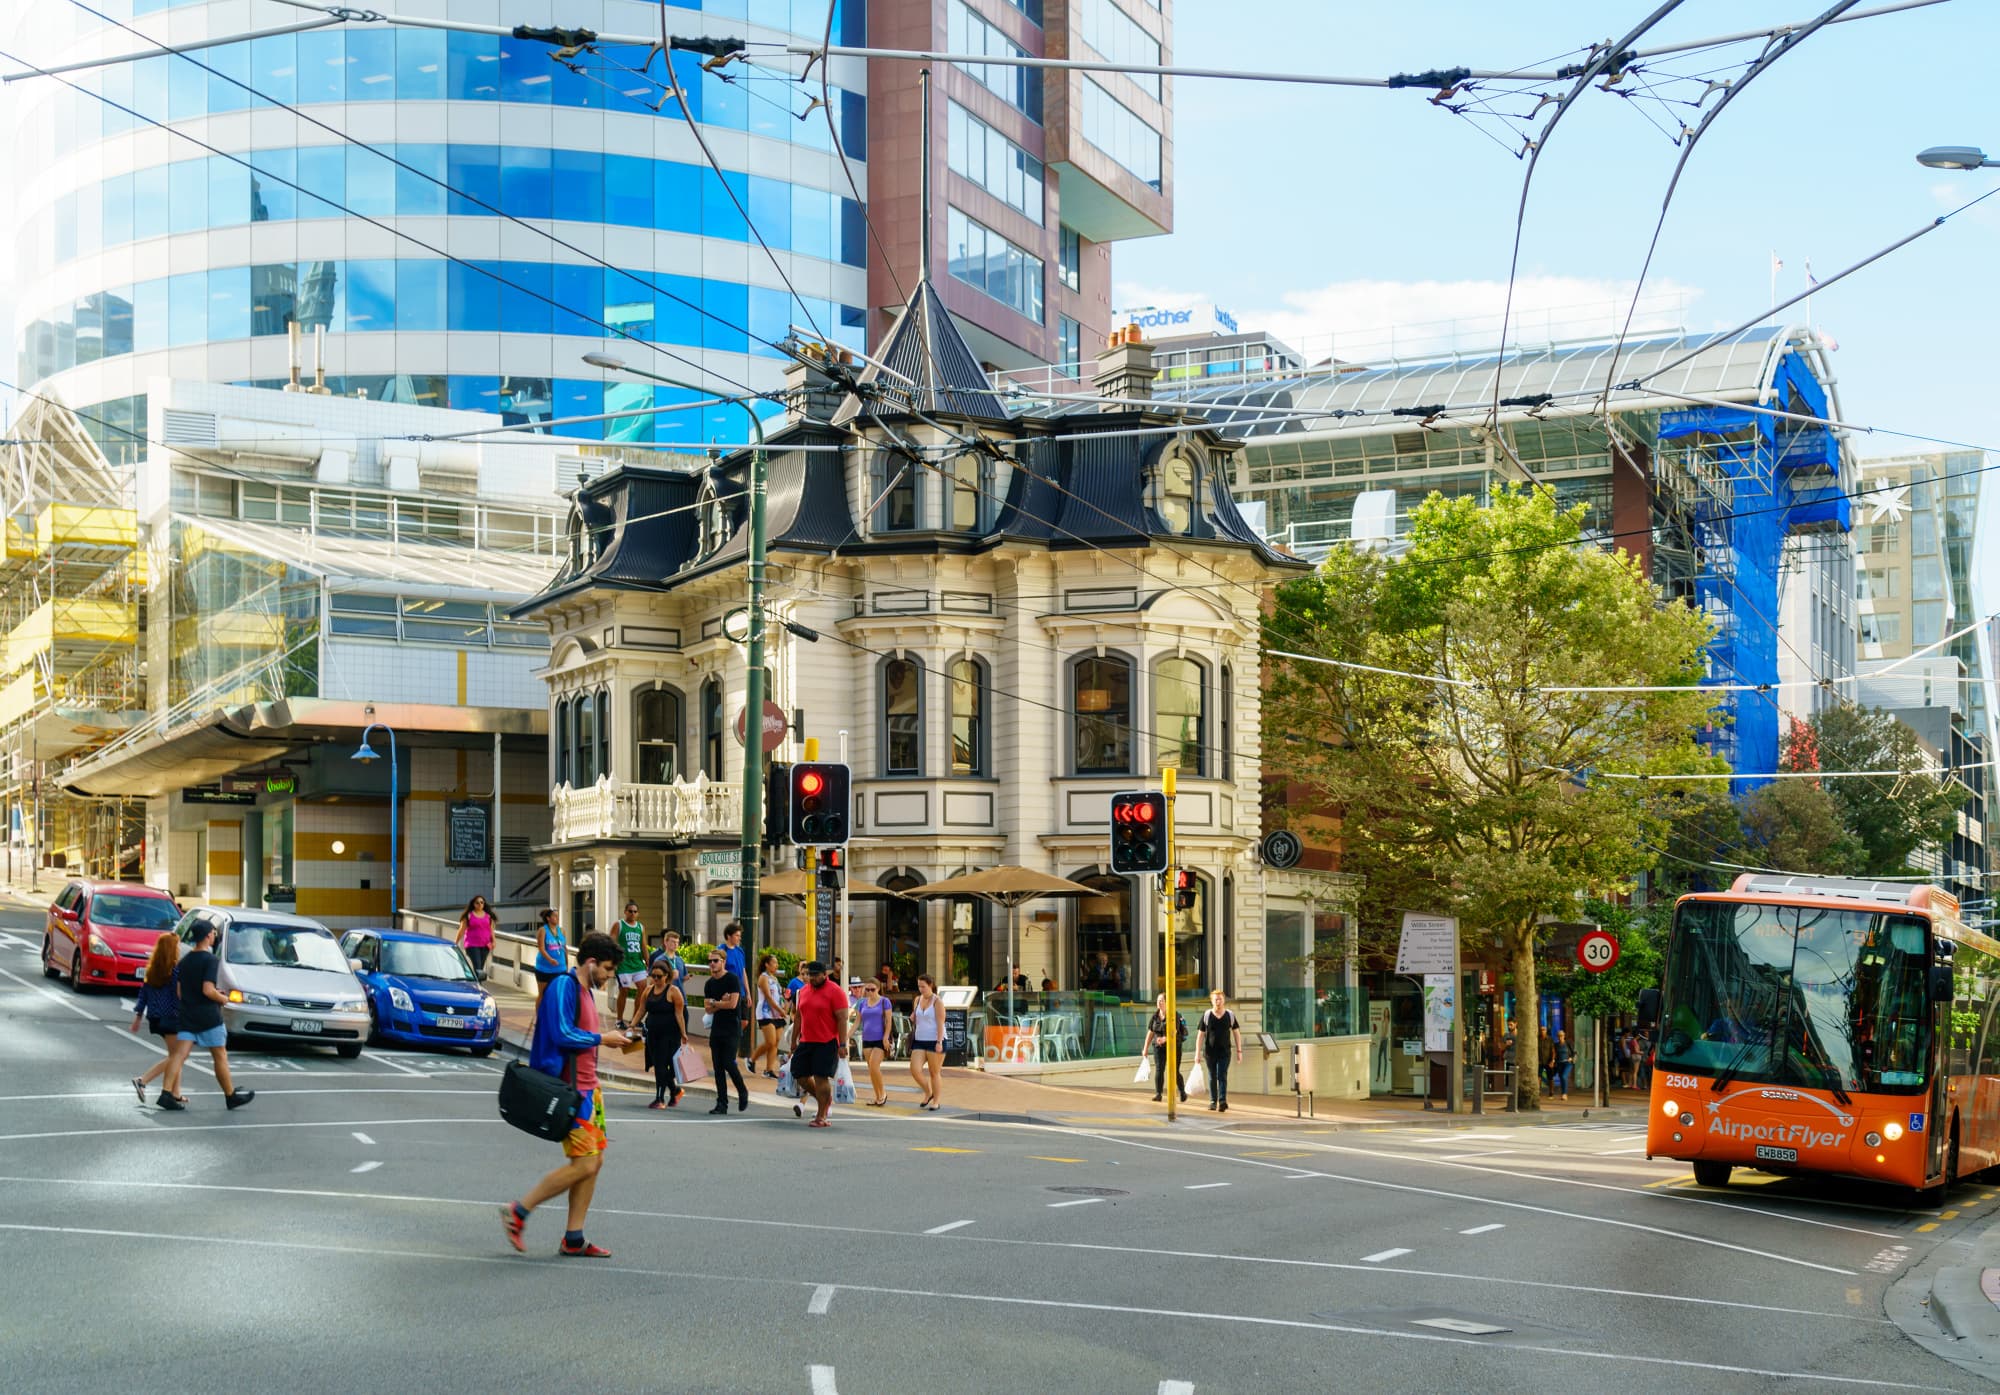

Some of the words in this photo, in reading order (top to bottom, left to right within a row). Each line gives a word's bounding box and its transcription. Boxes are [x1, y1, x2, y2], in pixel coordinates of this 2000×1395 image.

[1130, 308, 1192, 328] brother
[709, 866, 729, 878] WILLIS
[627, 941, 641, 953] 33
[1588, 944, 1611, 960] 30
[1666, 1074, 1698, 1089] 2504
